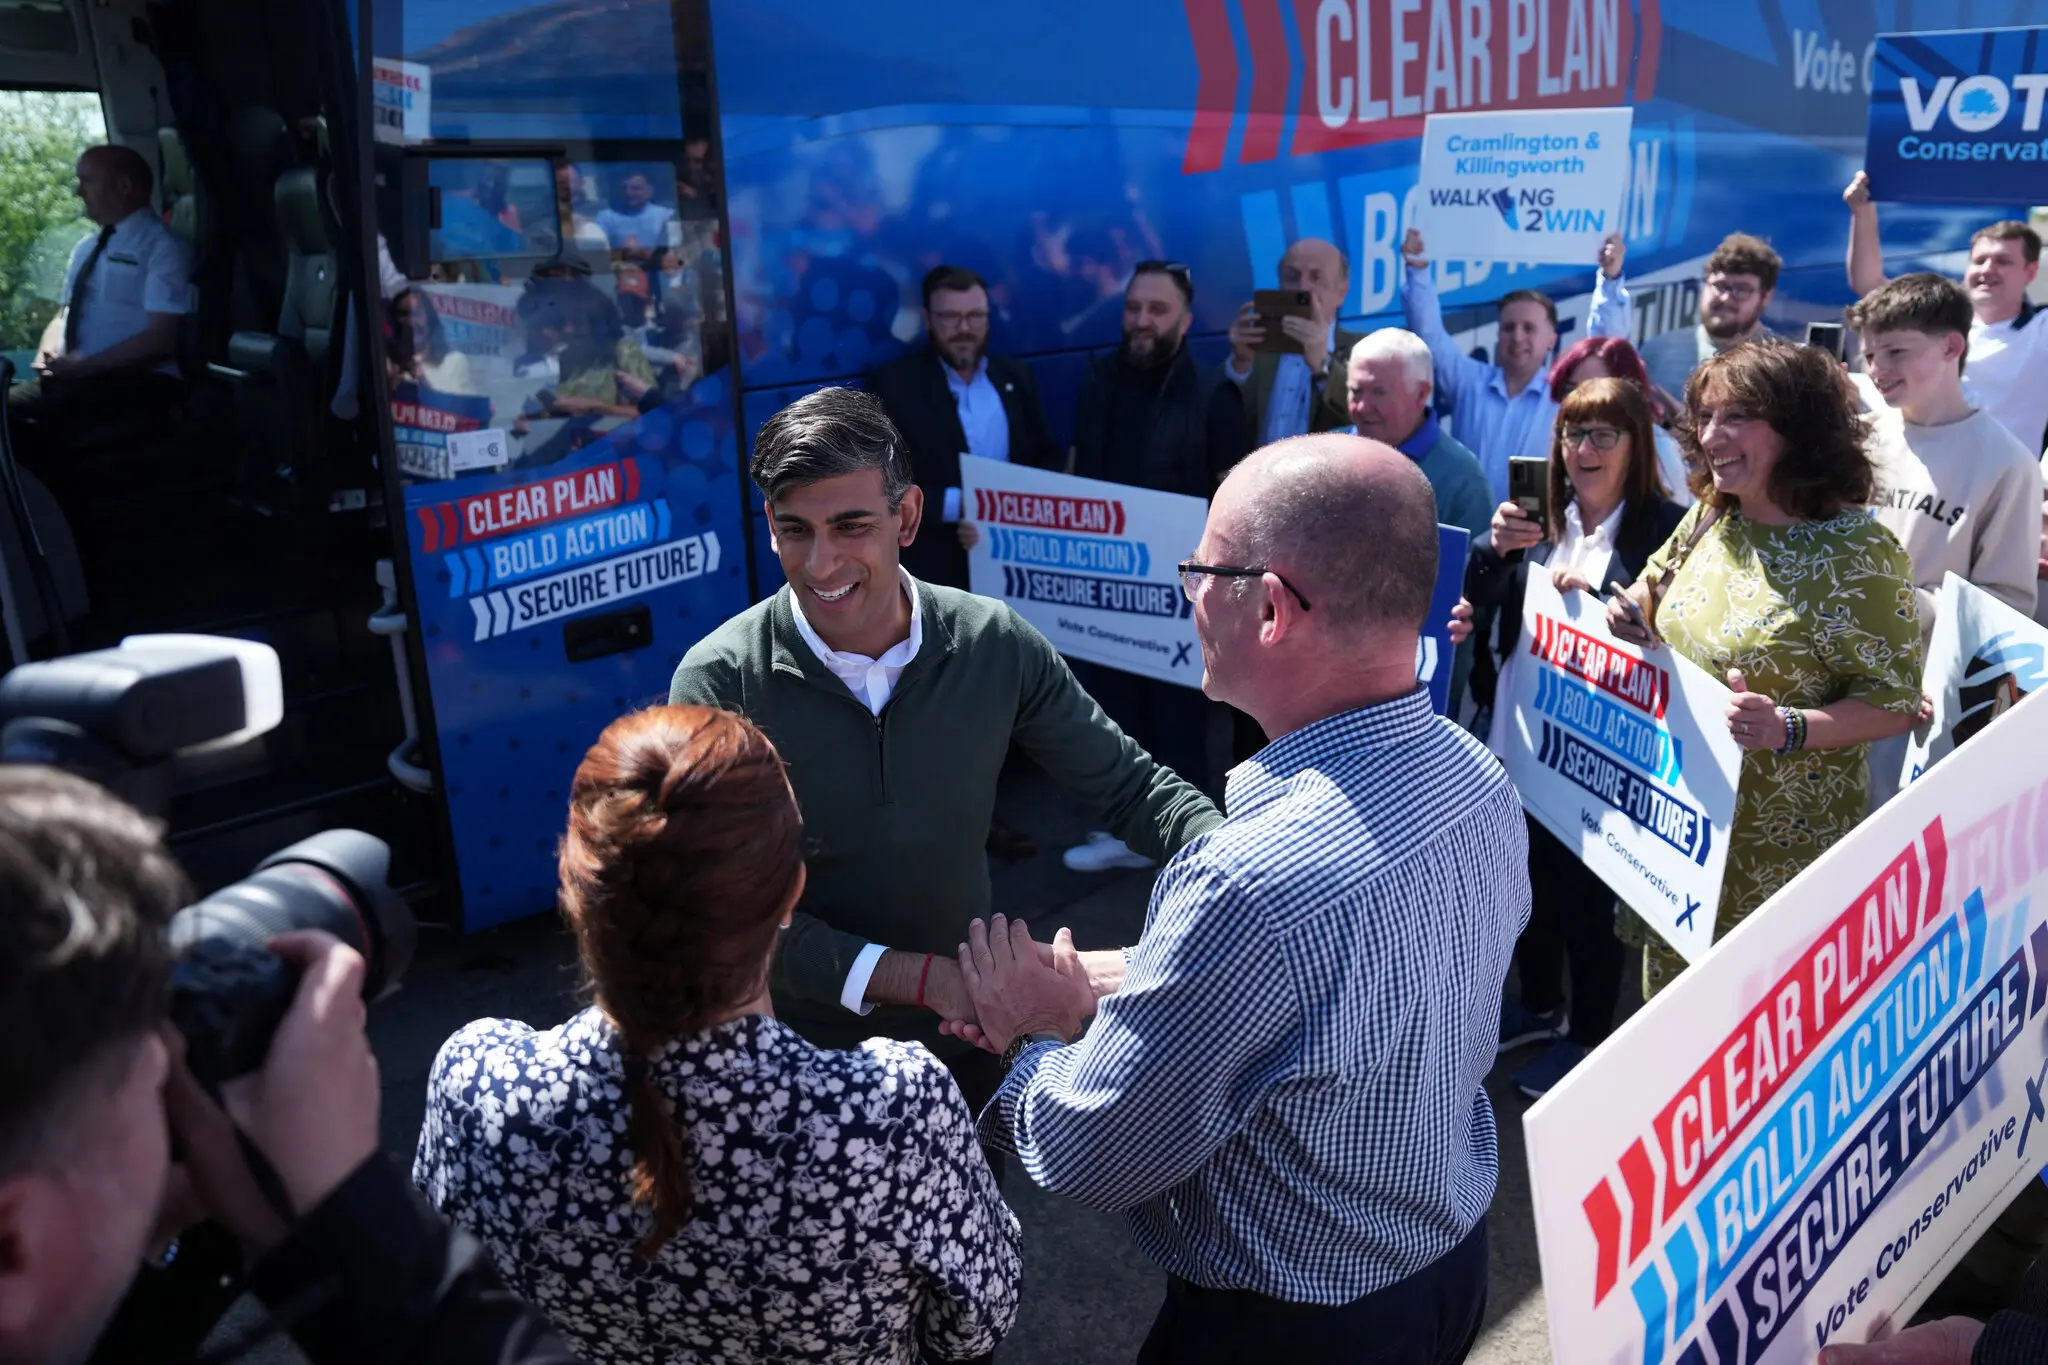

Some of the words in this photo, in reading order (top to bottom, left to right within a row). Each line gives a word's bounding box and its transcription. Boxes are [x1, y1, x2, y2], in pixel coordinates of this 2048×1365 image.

[1316, 0, 1492, 128] CLEAR
[1507, 0, 1619, 101] PLAN
[1794, 28, 1856, 95] Vote
[1446, 132, 1579, 155] Cramlington
[1584, 131, 1600, 150] &
[1455, 156, 1585, 178] Killingworth
[1525, 208, 1606, 232] 2WIN
[467, 485, 549, 536] CLEAR
[554, 468, 617, 514] PLAN
[1000, 495, 1056, 526] CLEAR
[1059, 499, 1106, 530] PLAN
[494, 533, 559, 581] BOLD
[565, 509, 649, 560] ACTION
[519, 568, 609, 622] SECURE
[615, 542, 699, 596] FUTURE
[1017, 534, 1061, 563] BOLD
[1066, 540, 1130, 572] ACTION
[1032, 573, 1096, 606] SECURE
[1101, 581, 1173, 615] FUTURE
[1058, 617, 1086, 635] Vote
[1088, 625, 1172, 655] Conservative
[1557, 627, 1607, 682] CLEAR
[1609, 650, 1653, 707] PLAN
[1561, 685, 1603, 735] BOLD
[1604, 708, 1665, 771] ACTION
[1564, 740, 1624, 808] SECURE
[1626, 773, 1696, 851] FUTURE
[1580, 807, 1604, 838] Vote
[1606, 833, 1679, 905] Conservative
[1669, 983, 1804, 1188] CLEAR
[1813, 860, 1911, 1039] PLAN
[1714, 1106, 1816, 1270] BOLD
[1827, 930, 1951, 1140] ACTION
[1752, 1123, 1892, 1342] SECURE
[1900, 960, 2020, 1155] FUTURE
[1815, 1277, 1870, 1348] Vote
[1876, 1115, 2016, 1279] Conservative
